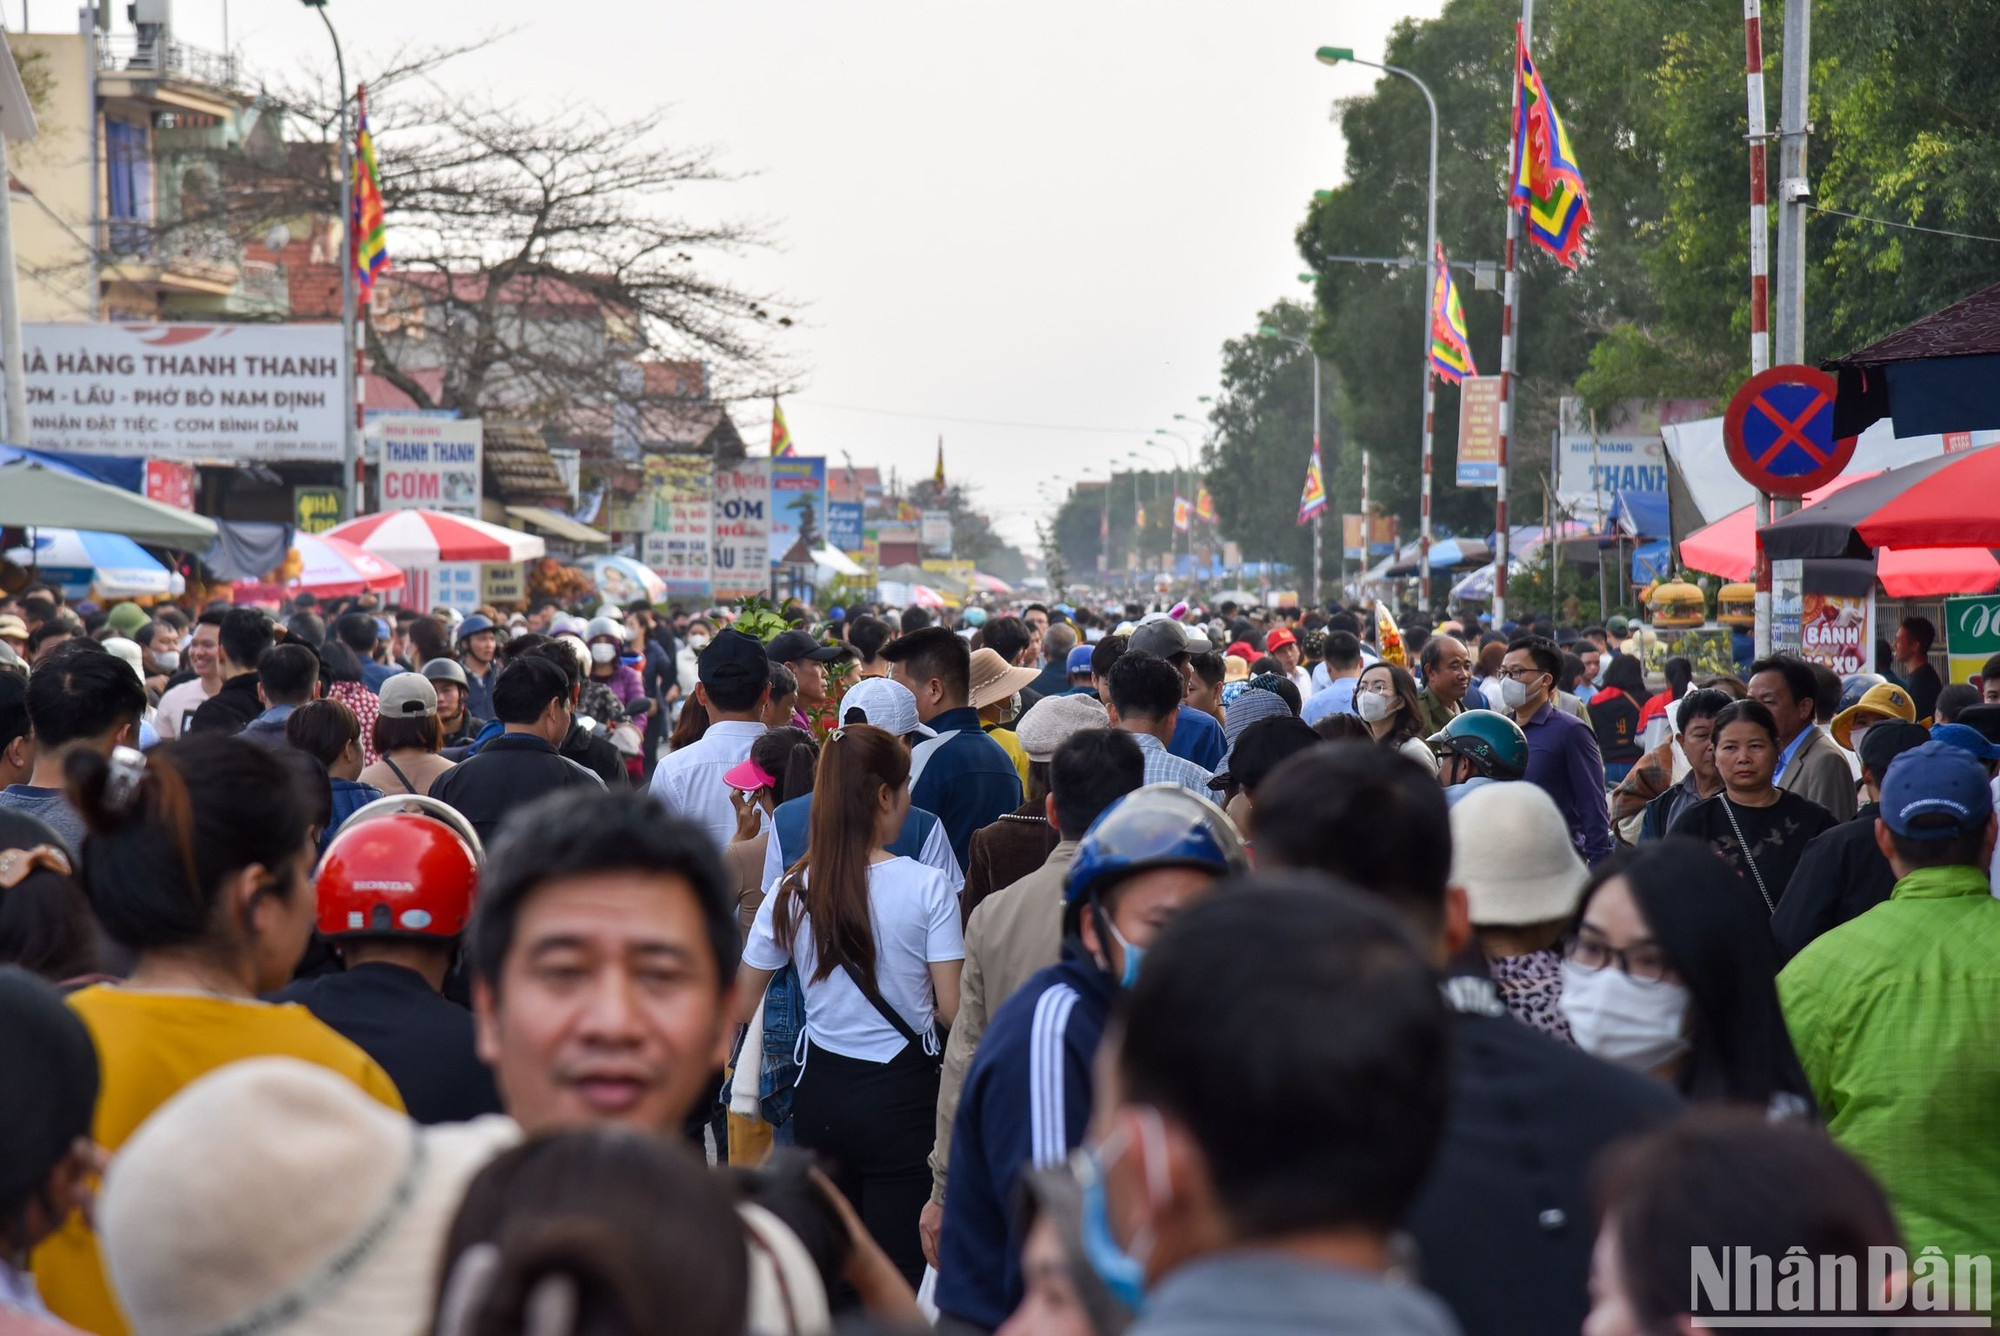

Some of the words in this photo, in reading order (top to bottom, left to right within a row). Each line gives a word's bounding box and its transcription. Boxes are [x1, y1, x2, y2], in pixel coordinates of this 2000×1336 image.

[56, 348, 135, 375] HÀNG
[143, 355, 236, 376] THANH
[244, 356, 337, 377] THANH
[26, 387, 55, 404] ƠM
[134, 384, 180, 406] PHỞ
[185, 386, 214, 407] BÒ
[221, 390, 267, 407] NAM
[274, 391, 325, 413] ĐỊNH
[32, 413, 81, 435] NHẬN
[123, 413, 159, 435] TIỆC
[174, 417, 214, 433] CƠM
[220, 415, 259, 433] BÌNH
[264, 416, 298, 433] DÂN
[387, 442, 428, 462] THANH
[433, 442, 475, 463] THANH
[385, 468, 439, 499] CƠM
[1807, 622, 1859, 644] BÁNH
[1832, 655, 1858, 673] XU
[353, 880, 415, 891] HONDA
